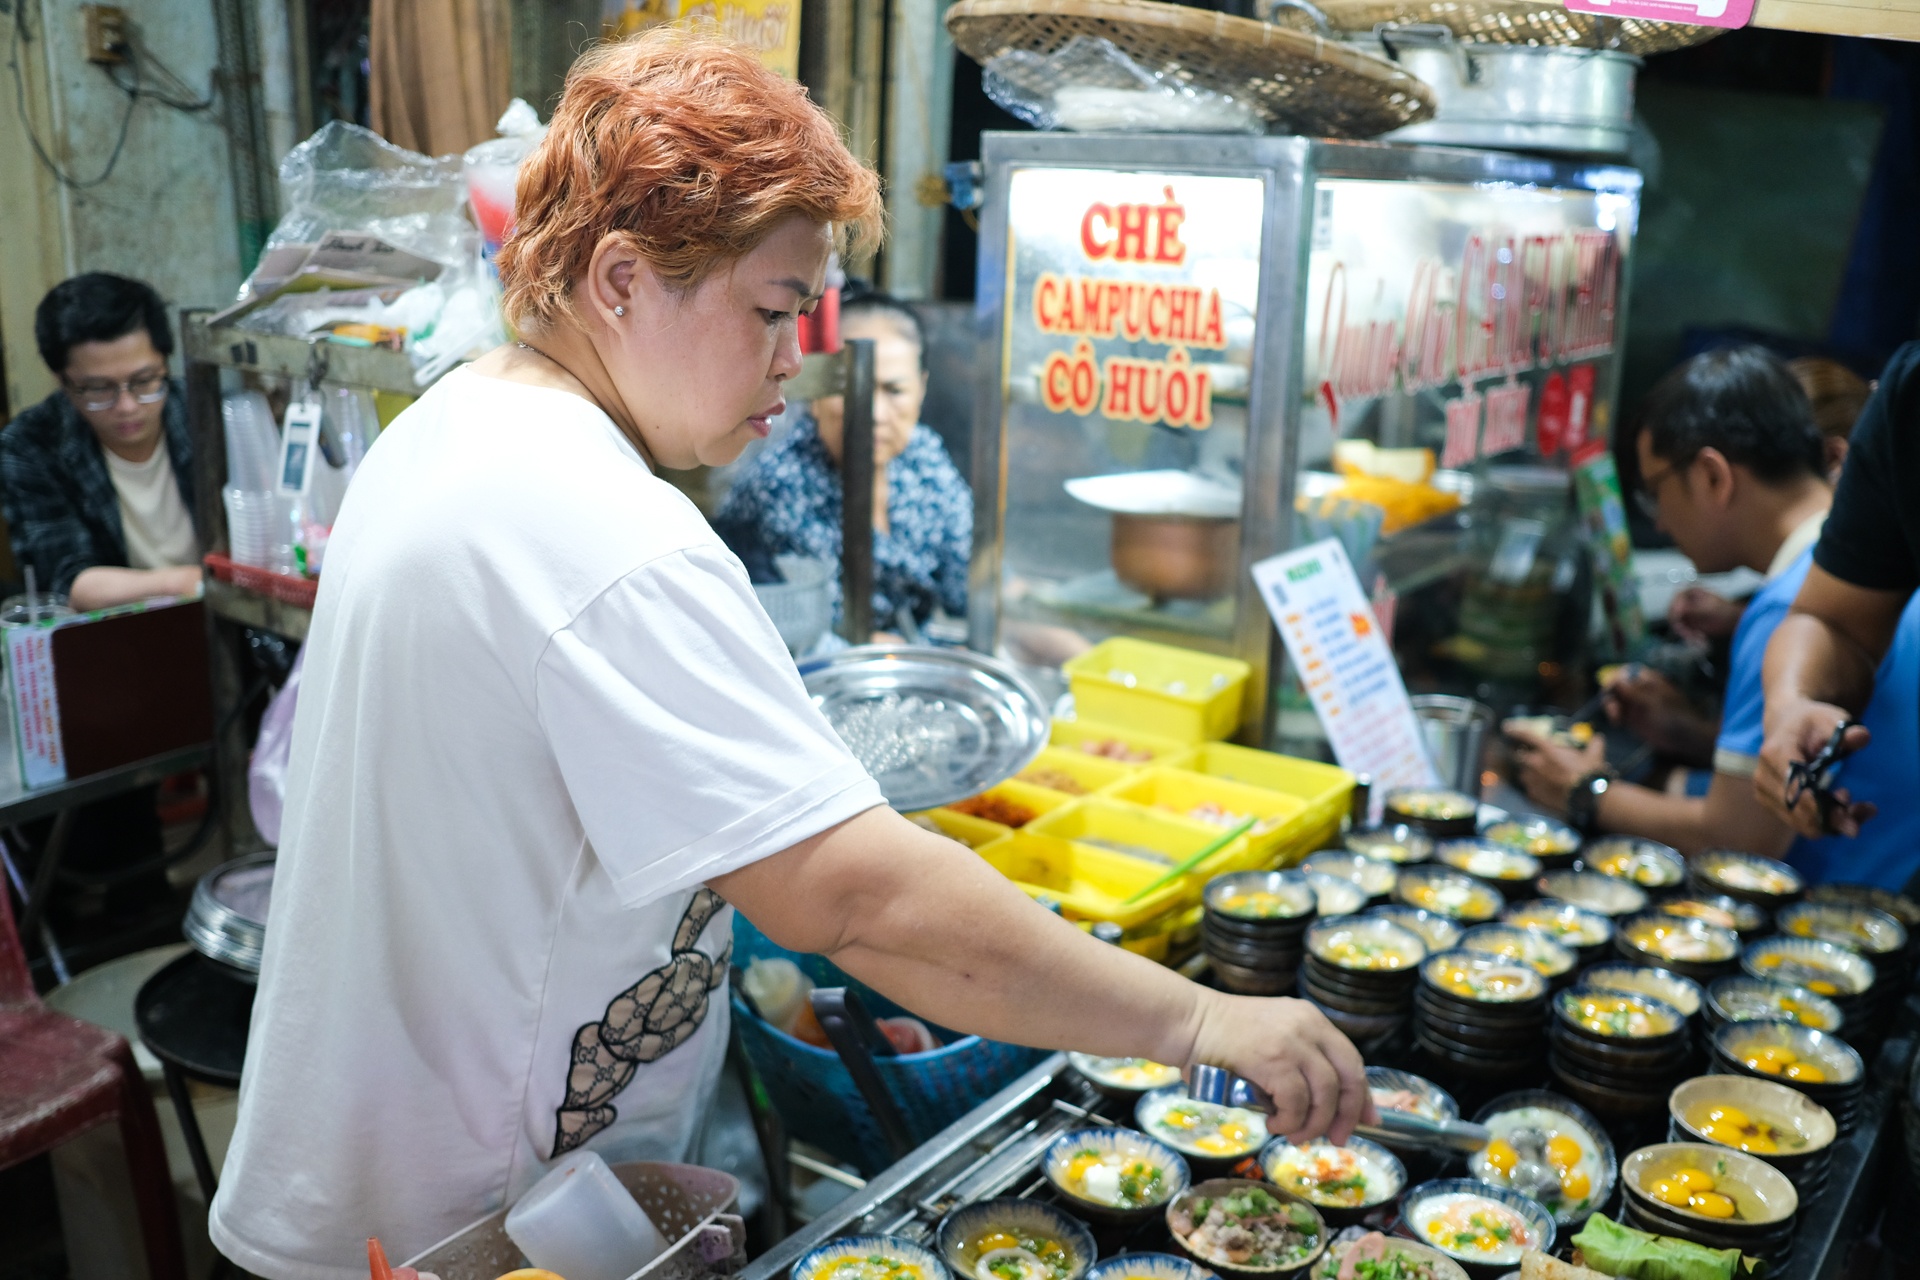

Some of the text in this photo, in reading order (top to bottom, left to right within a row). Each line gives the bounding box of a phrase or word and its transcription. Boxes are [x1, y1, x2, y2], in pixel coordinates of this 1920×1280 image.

[1081, 184, 1186, 265] CHÈ
[1036, 275, 1225, 348] CAMPUCHIA
[1044, 340, 1211, 428] CÔ HUÔI
